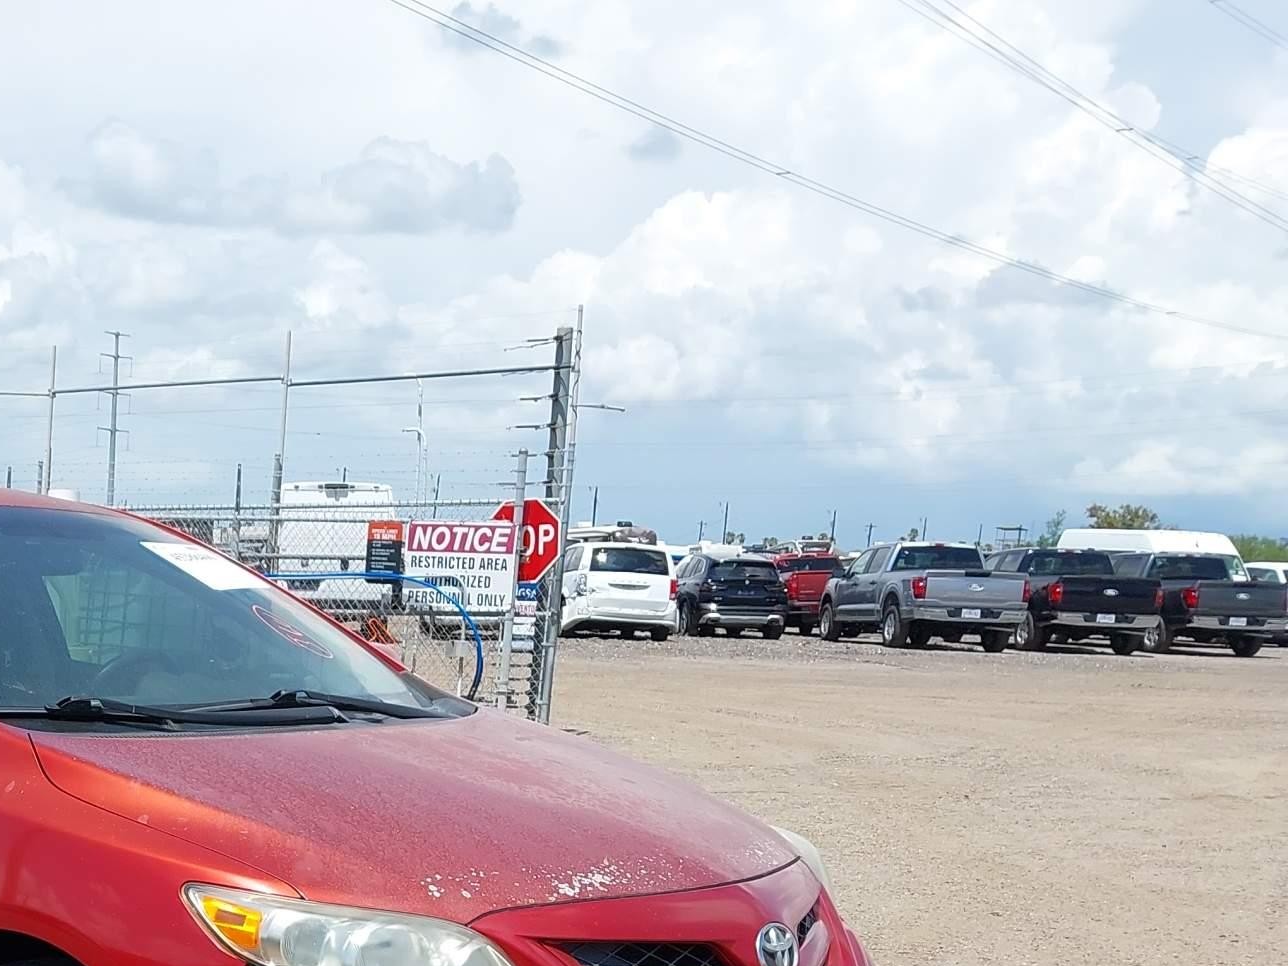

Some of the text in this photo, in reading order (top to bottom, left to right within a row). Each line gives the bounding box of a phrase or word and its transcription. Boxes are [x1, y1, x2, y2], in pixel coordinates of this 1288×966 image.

[412, 526, 511, 552] NOTICE
[519, 524, 555, 556] OP
[411, 555, 475, 570] RESTRICTED
[479, 557, 508, 571] AREA
[407, 590, 506, 606] PERSONNL ONLY
